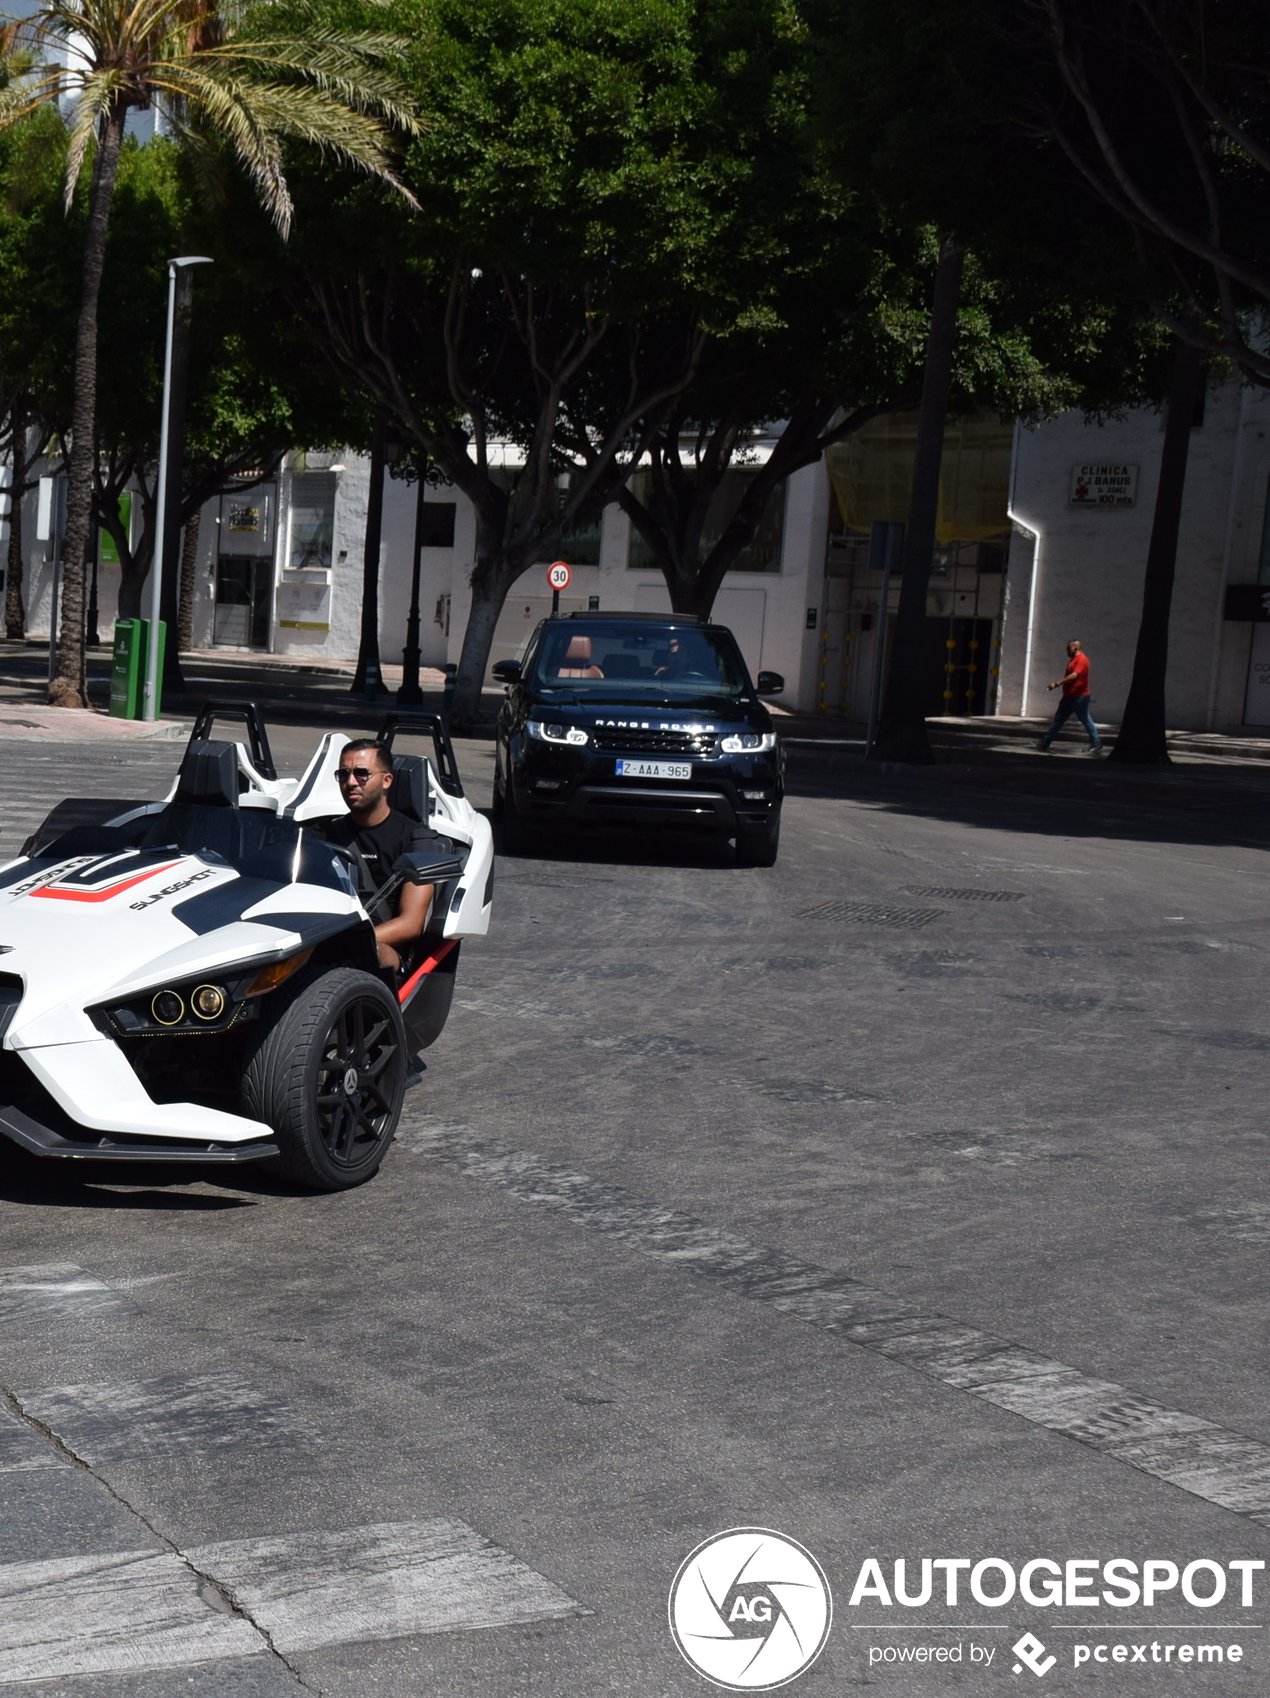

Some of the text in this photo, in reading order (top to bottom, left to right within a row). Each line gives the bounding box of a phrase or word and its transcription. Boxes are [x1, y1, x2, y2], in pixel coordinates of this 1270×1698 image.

[1081, 466, 1128, 475] CLINICA
[1095, 477, 1131, 485] BANUS
[1099, 495, 1115, 504] 100
[553, 571, 566, 582] 30
[595, 720, 715, 731] RANGE ROVER
[624, 763, 690, 777] Z-AAA-965
